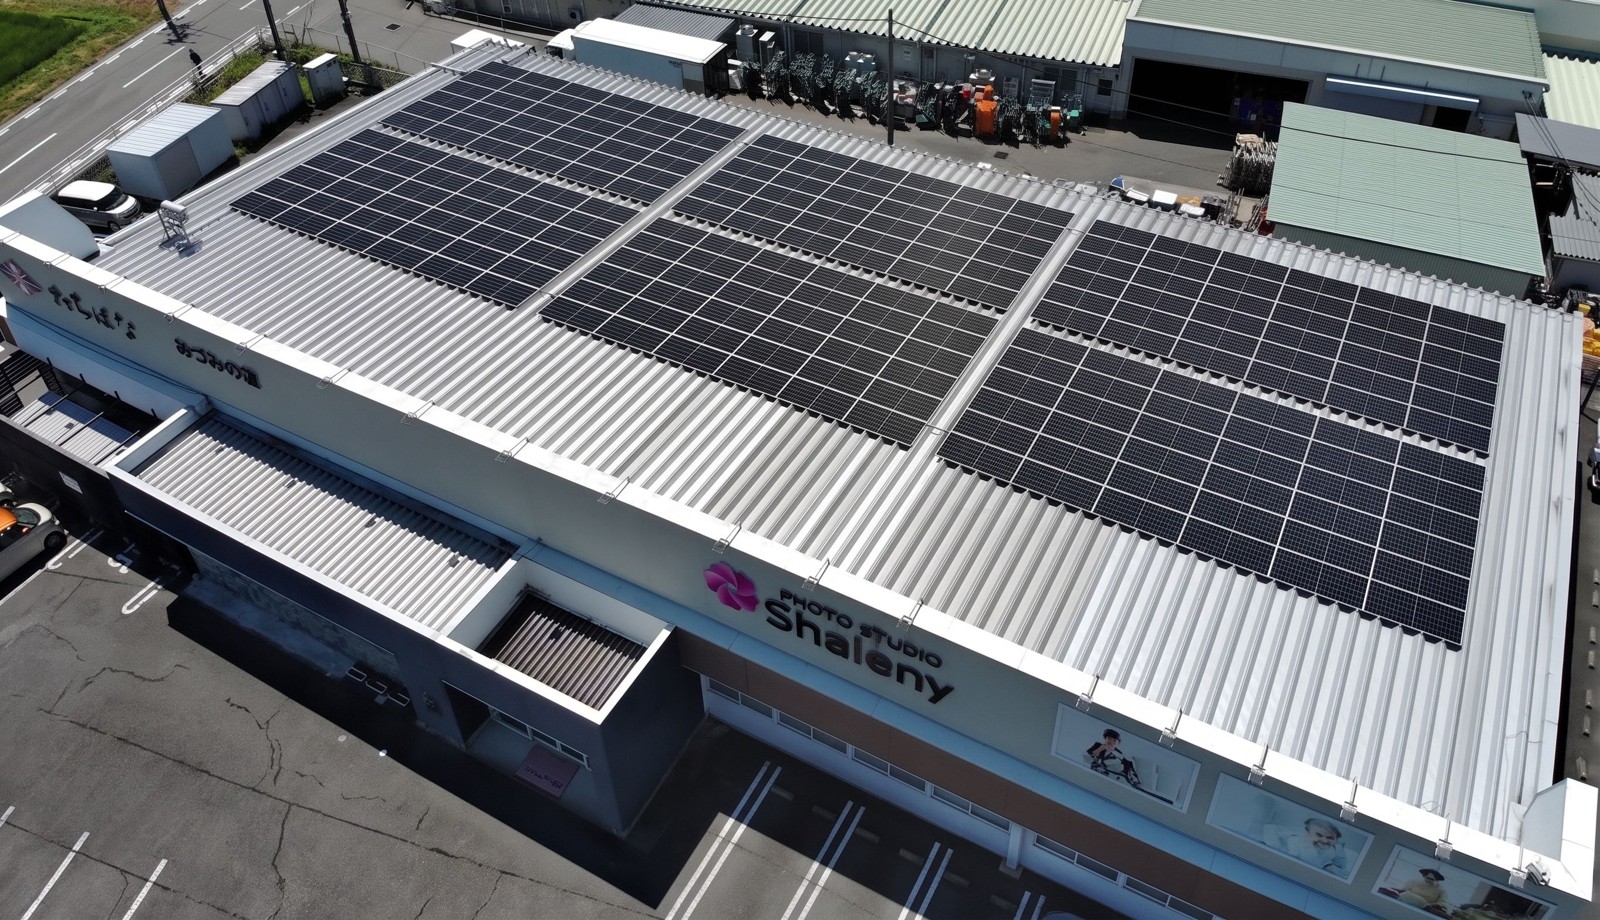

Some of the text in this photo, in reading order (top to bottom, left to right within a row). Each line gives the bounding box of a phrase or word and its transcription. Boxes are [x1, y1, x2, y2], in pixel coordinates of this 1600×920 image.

[764, 598, 955, 705] Shaleny
[780, 587, 944, 669] PHOTO STUDIO
